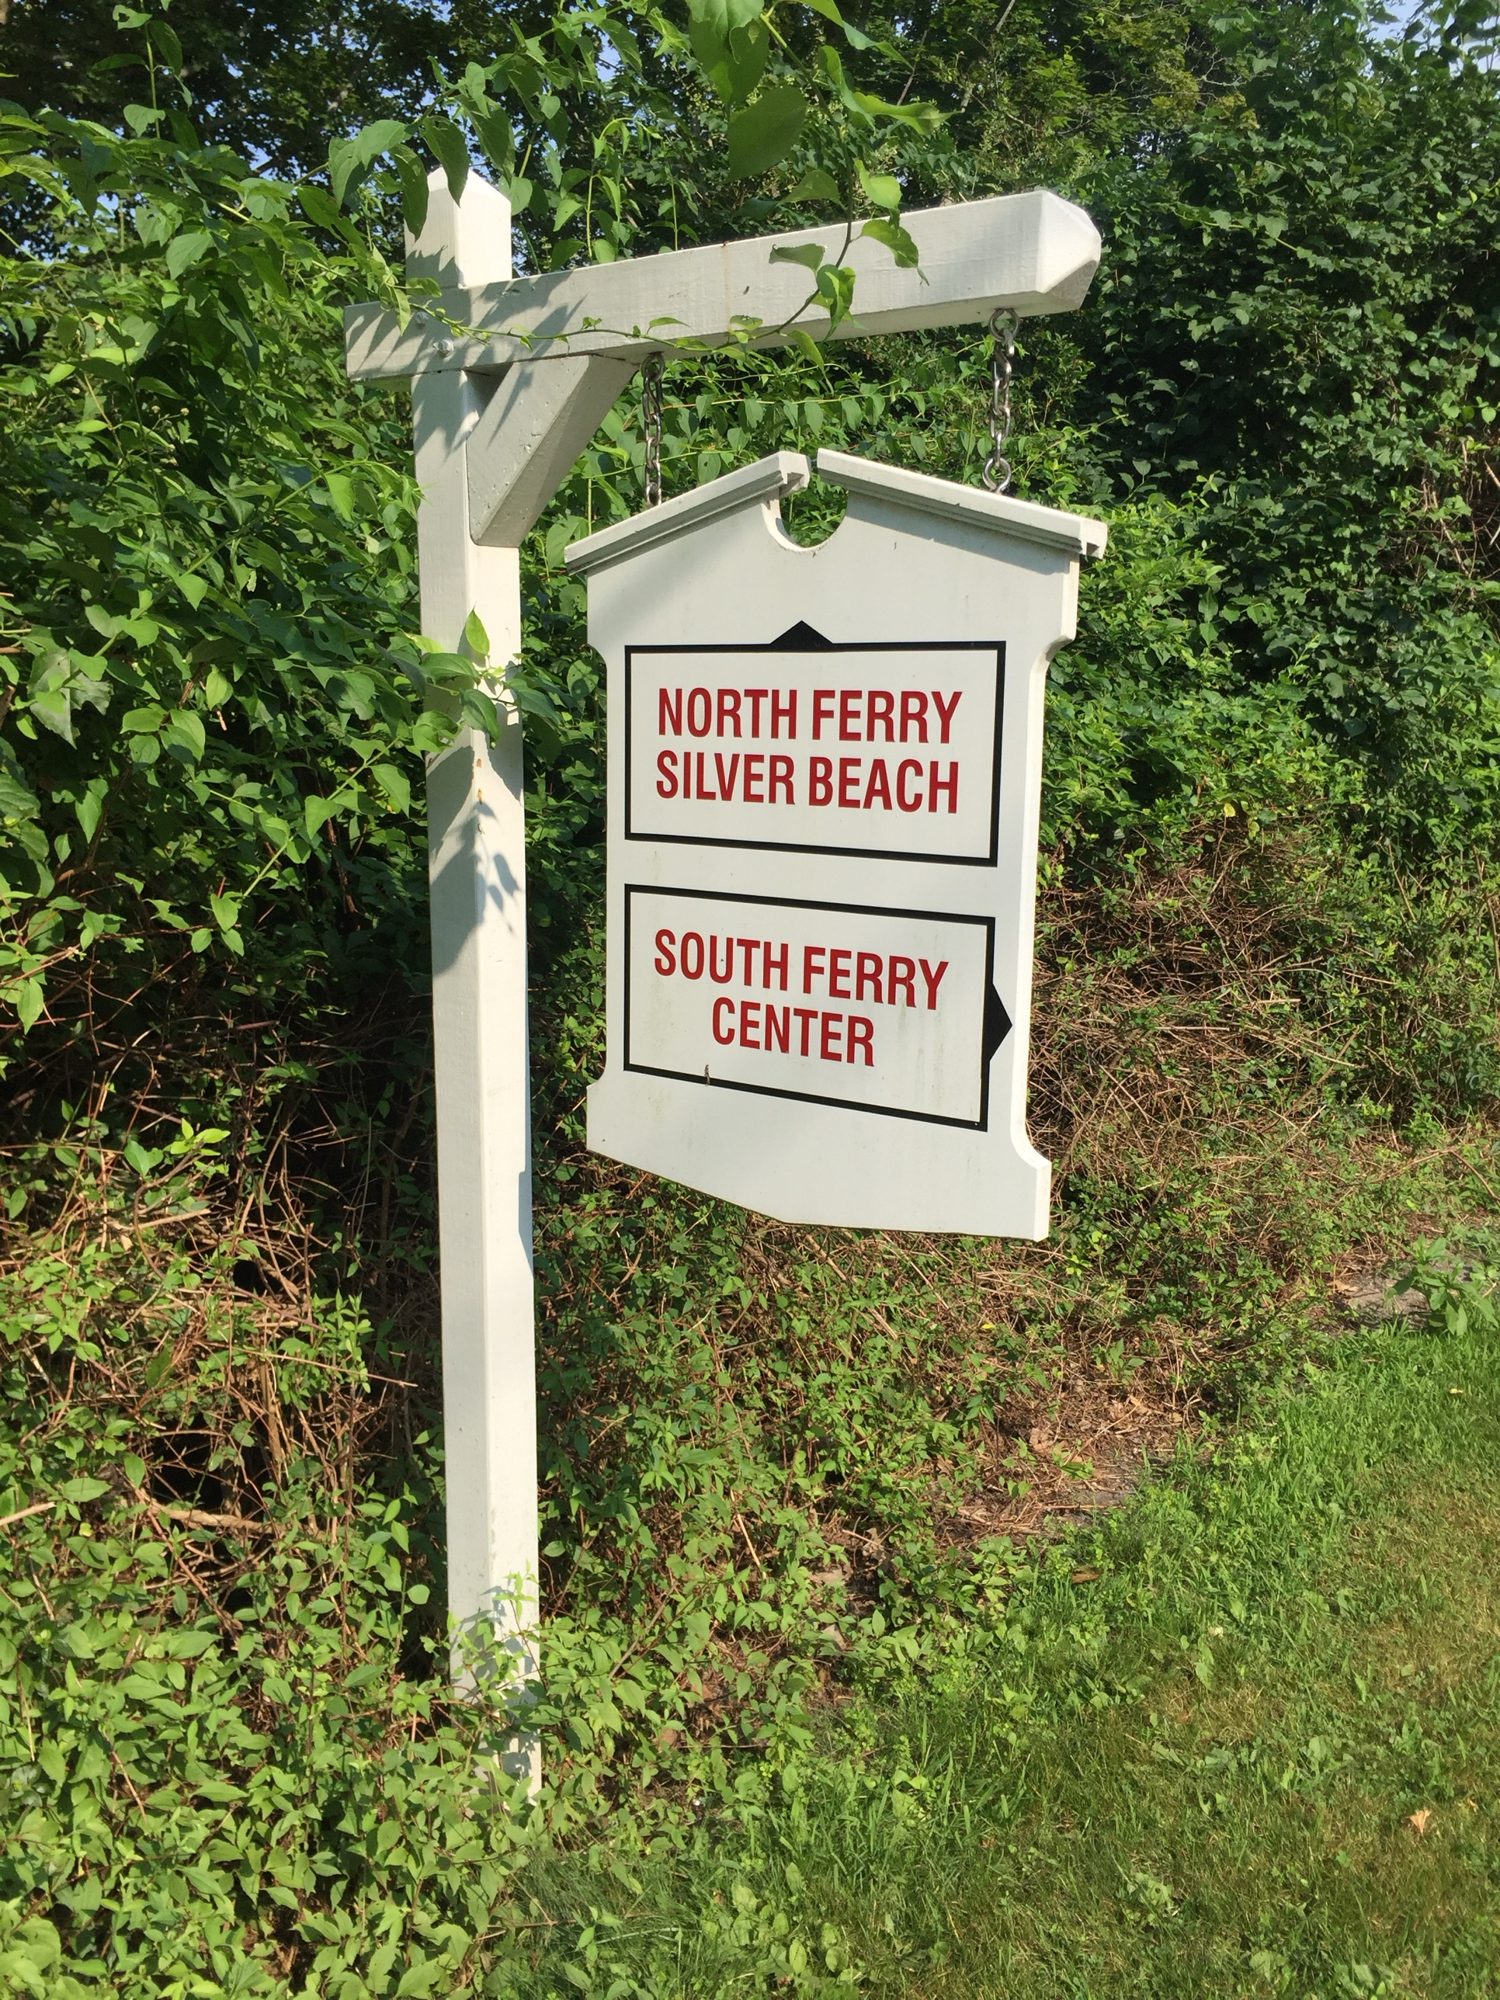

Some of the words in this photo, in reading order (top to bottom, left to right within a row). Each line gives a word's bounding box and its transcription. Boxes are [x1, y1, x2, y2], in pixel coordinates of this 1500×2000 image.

[658, 687, 798, 739] NORTH
[812, 689, 961, 744] FERRY
[656, 750, 795, 805] SILVER
[808, 756, 960, 814] BEACH
[654, 928, 789, 991] SOUTH
[802, 945, 949, 1010] FERRY
[712, 996, 875, 1067] CENTER
